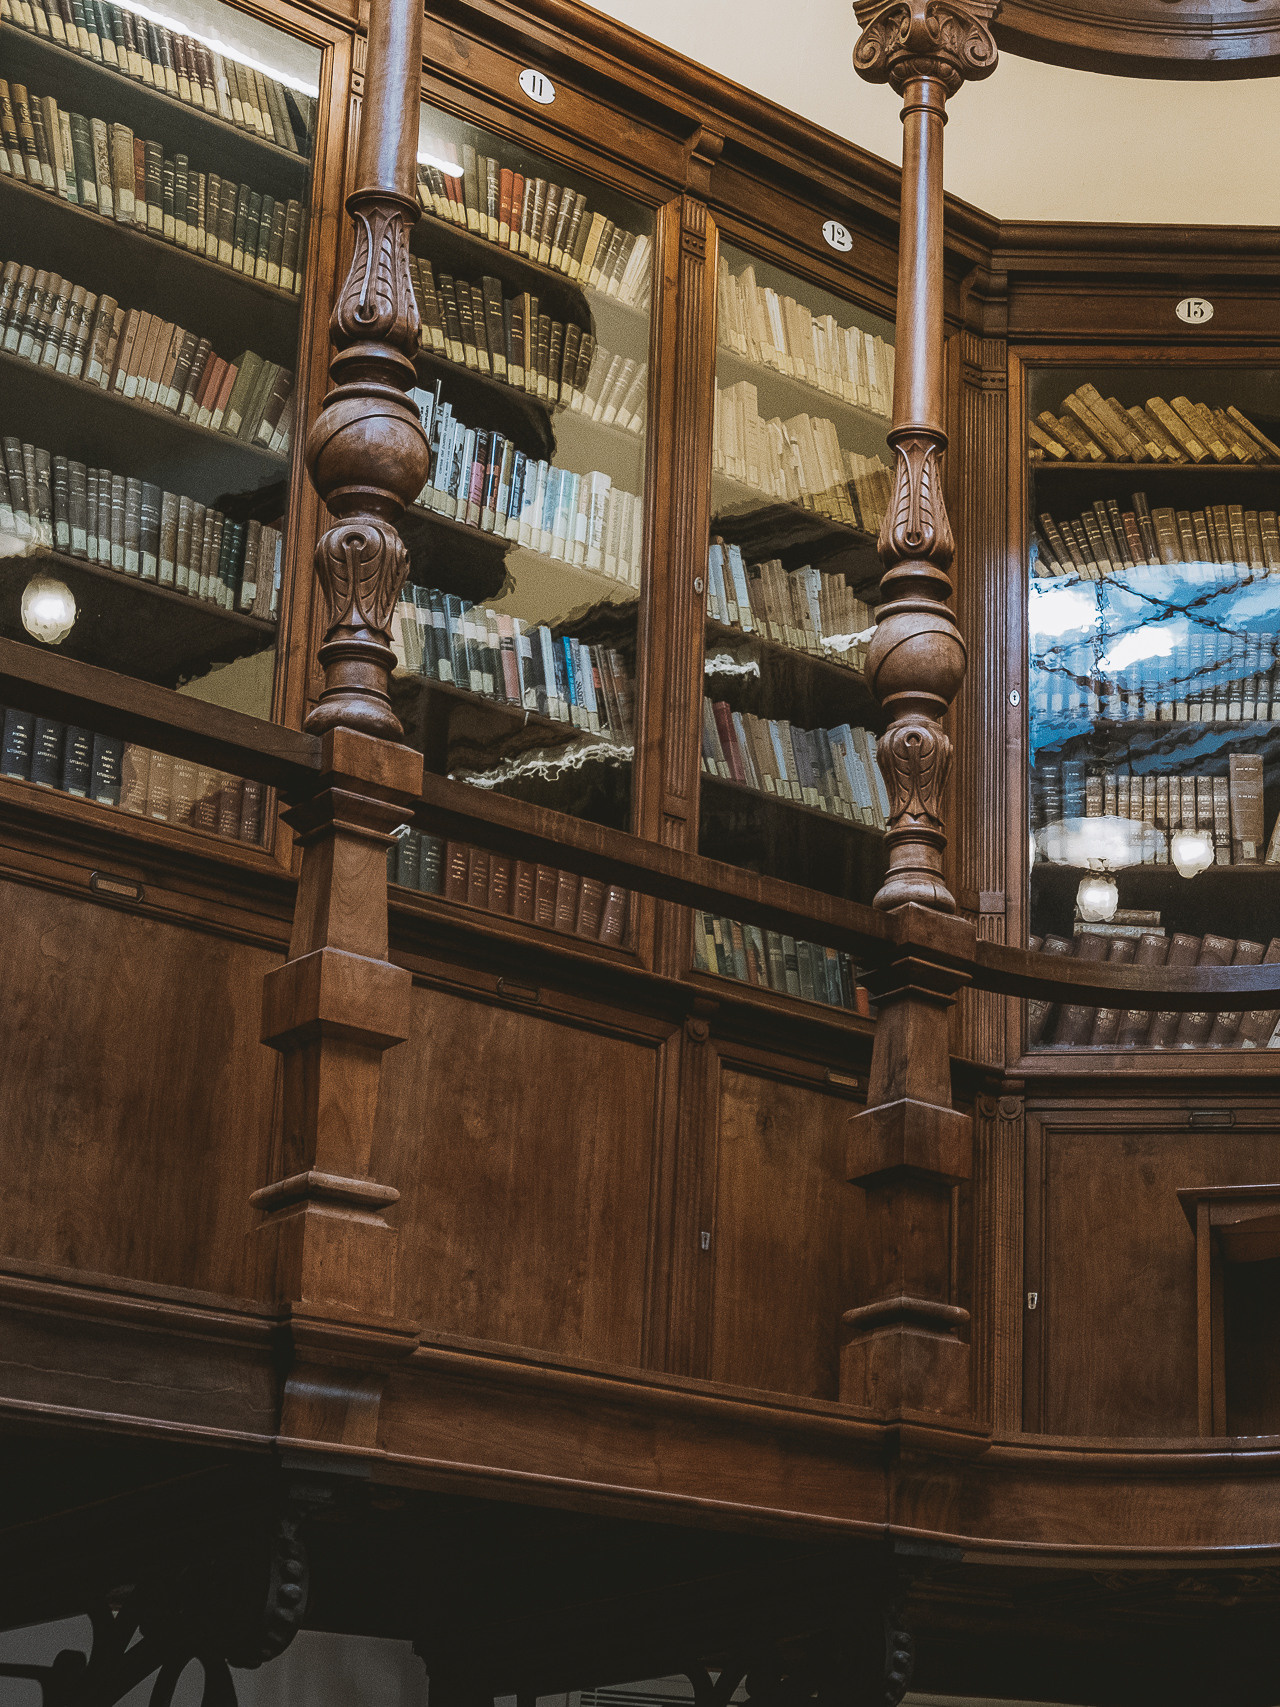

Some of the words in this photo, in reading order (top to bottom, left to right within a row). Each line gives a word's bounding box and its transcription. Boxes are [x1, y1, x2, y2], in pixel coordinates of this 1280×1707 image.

[532, 75, 543, 97] 11
[831, 224, 845, 246] 12
[1186, 301, 1205, 318] 13
